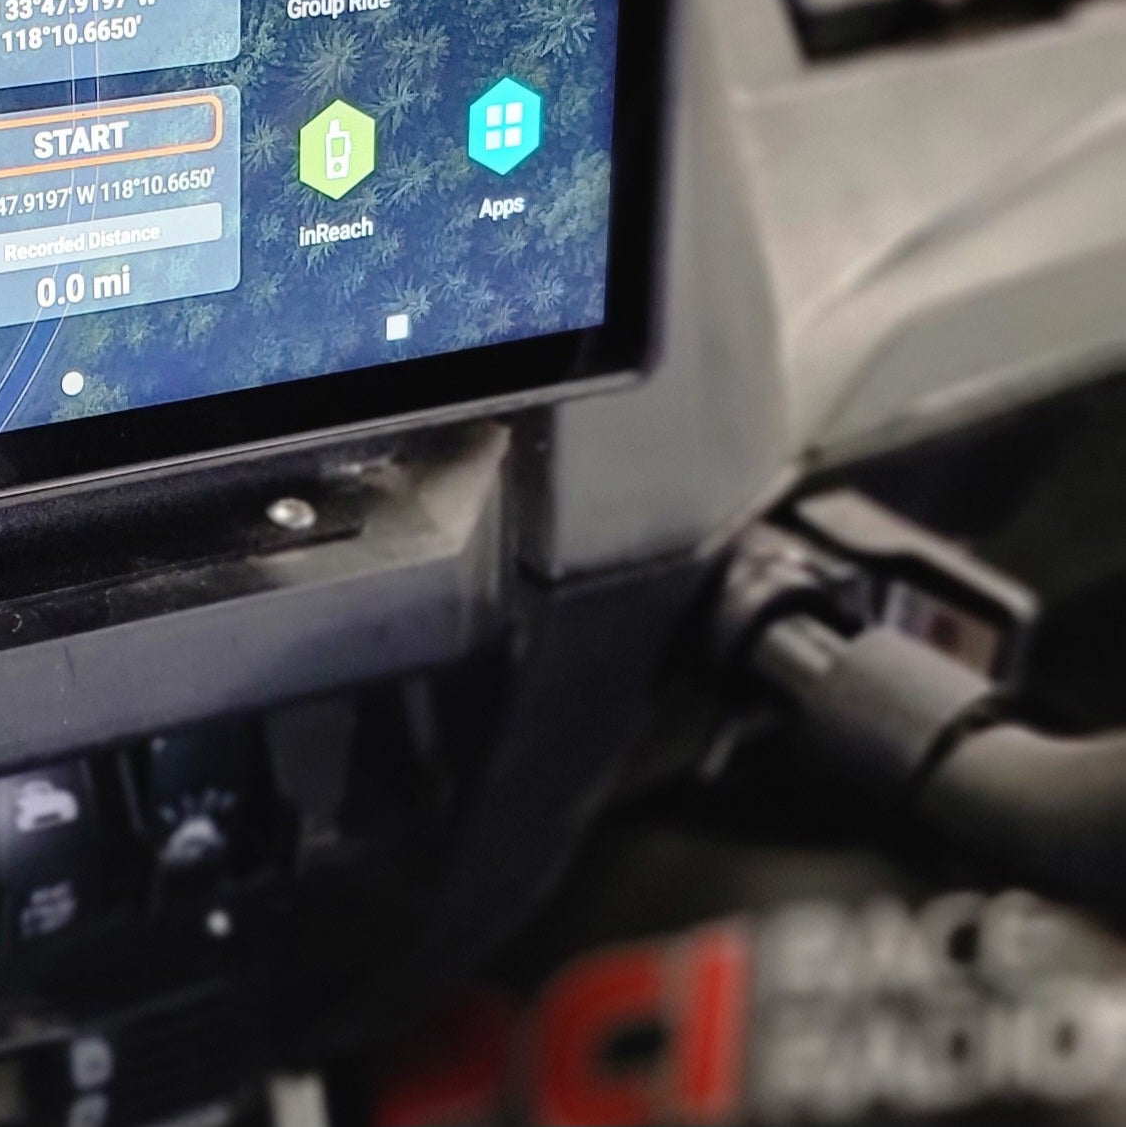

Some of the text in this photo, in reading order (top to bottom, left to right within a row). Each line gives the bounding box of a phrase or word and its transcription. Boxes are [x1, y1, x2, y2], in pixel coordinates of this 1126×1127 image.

[33, 121, 129, 159] START
[76, 184, 95, 205] W
[478, 194, 525, 220] Apps
[3, 224, 161, 262] Recorded Distance
[299, 216, 373, 247] inReach
[36, 265, 131, 308] 0.0 mi
